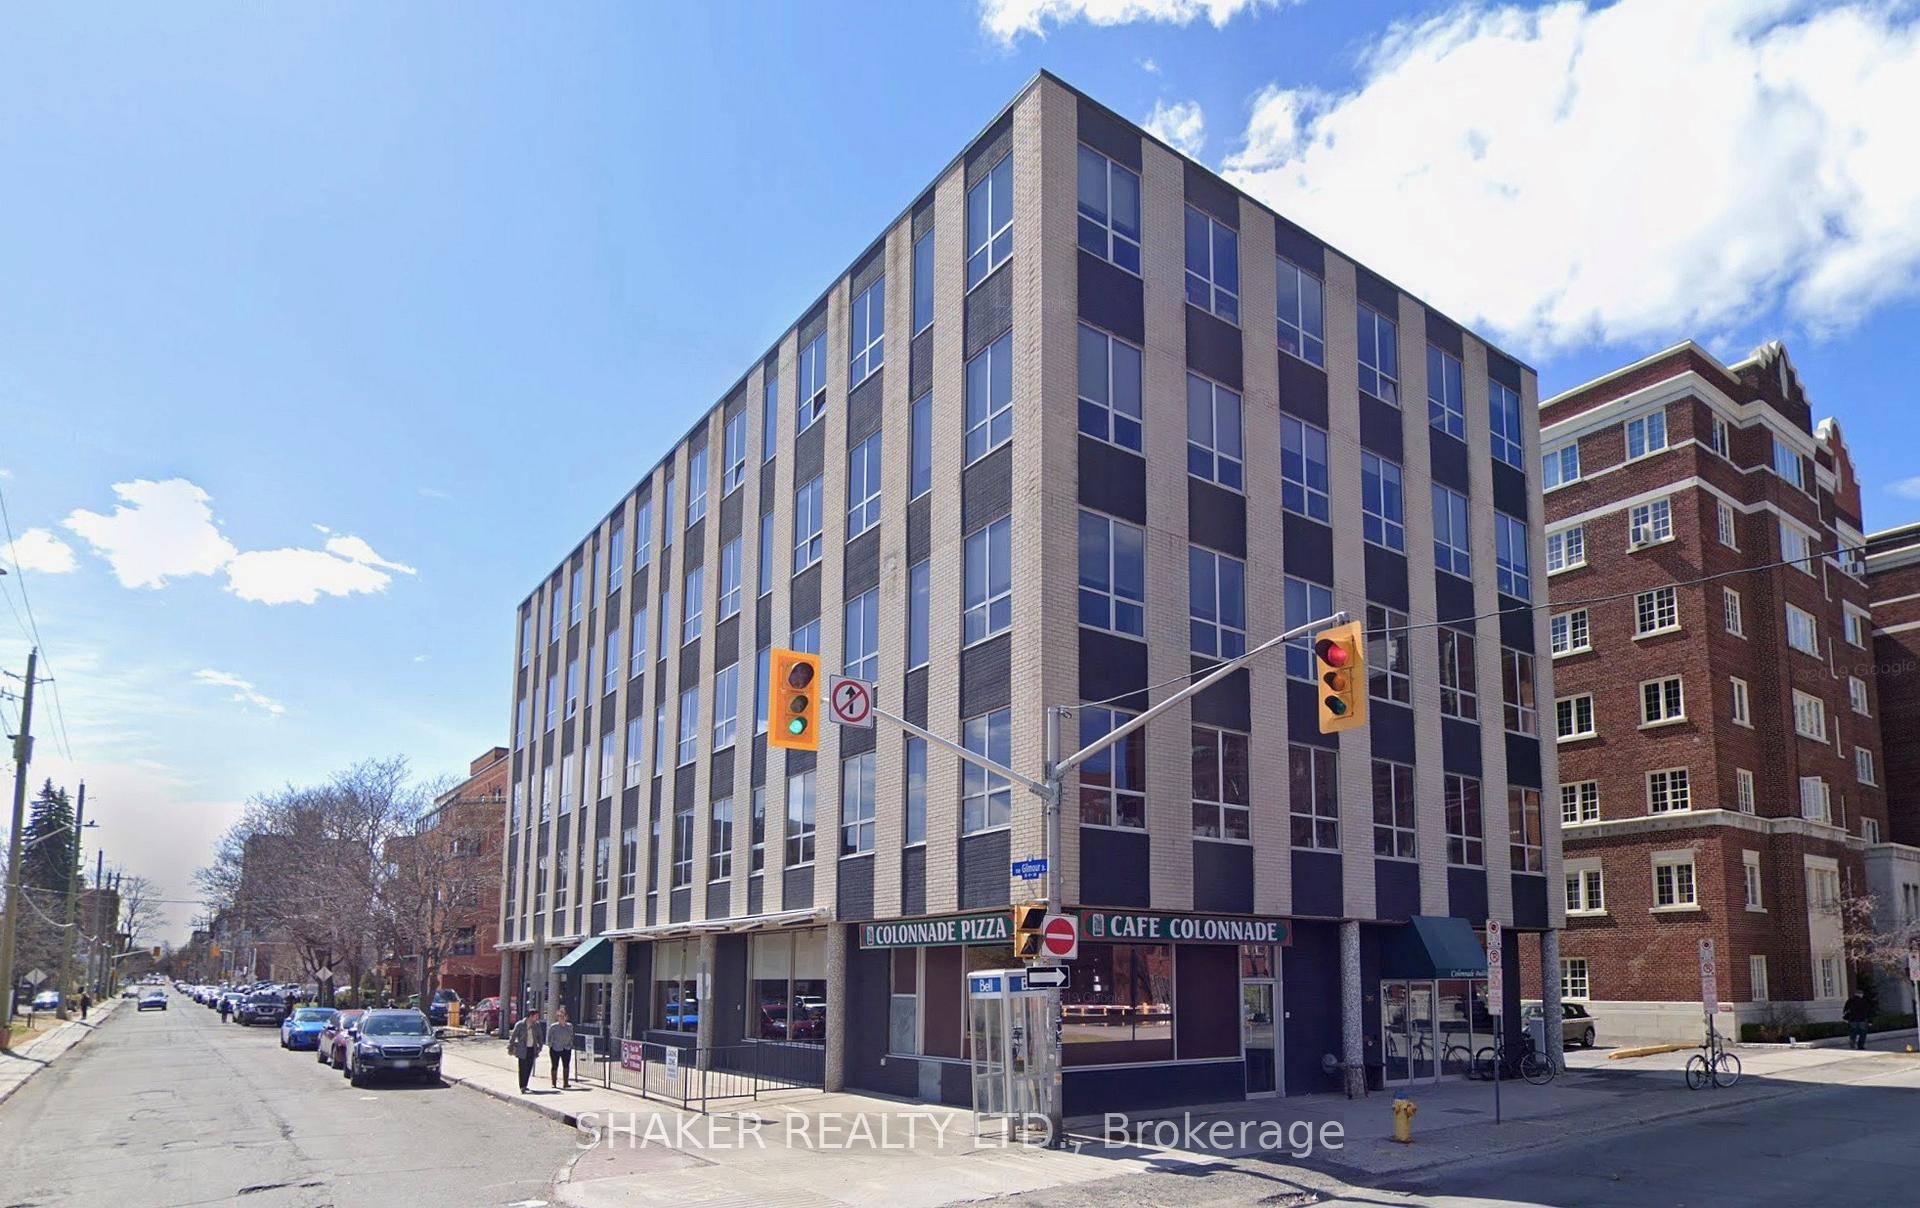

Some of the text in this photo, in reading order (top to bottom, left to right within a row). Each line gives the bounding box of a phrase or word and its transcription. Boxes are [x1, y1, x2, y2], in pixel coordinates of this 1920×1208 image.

[876, 917, 1007, 945] COLONNADE PIZZA
[1110, 915, 1278, 942] CAFE COLONNADE
[979, 978, 993, 992] Bell
